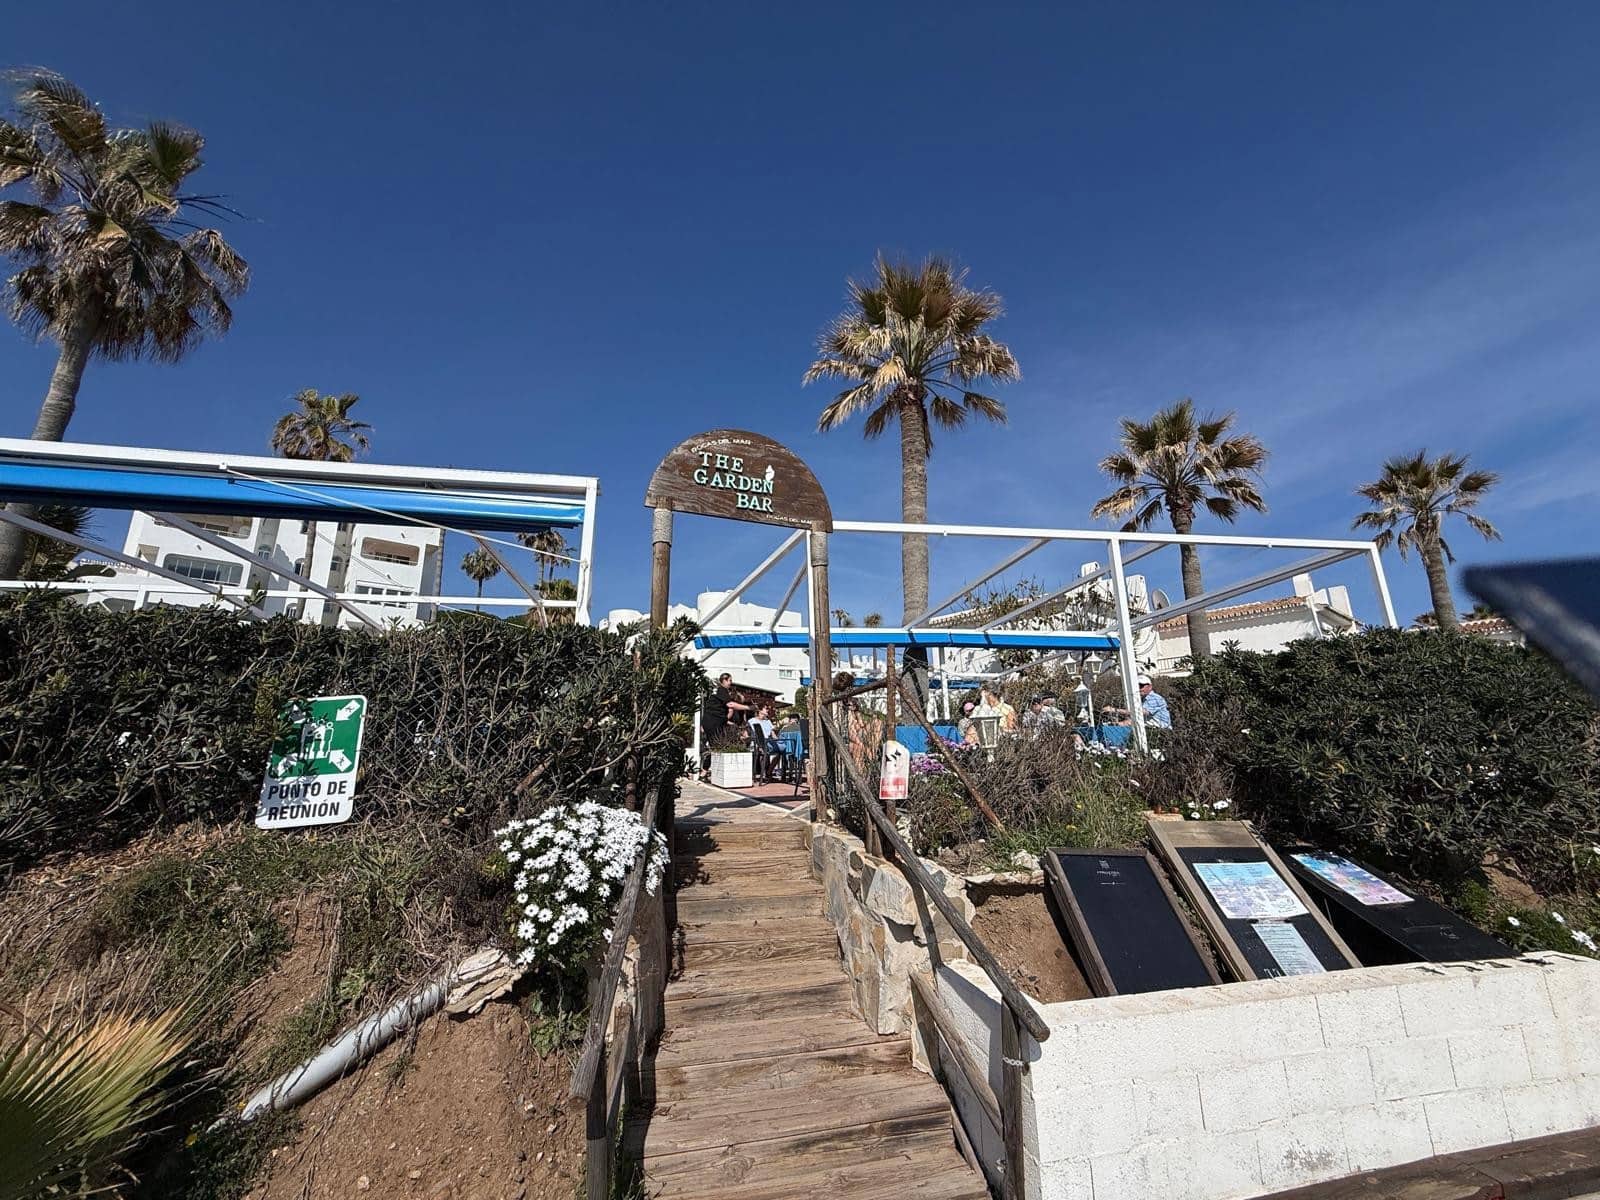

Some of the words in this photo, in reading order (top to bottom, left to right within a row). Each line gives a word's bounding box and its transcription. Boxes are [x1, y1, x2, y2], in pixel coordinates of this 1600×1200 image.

[699, 451, 744, 473] THE
[693, 468, 774, 495] GARDEN
[736, 492, 774, 513] BAR
[267, 782, 321, 800] PUNTO
[327, 780, 348, 796] DE
[267, 799, 341, 821] REUNIÓN
